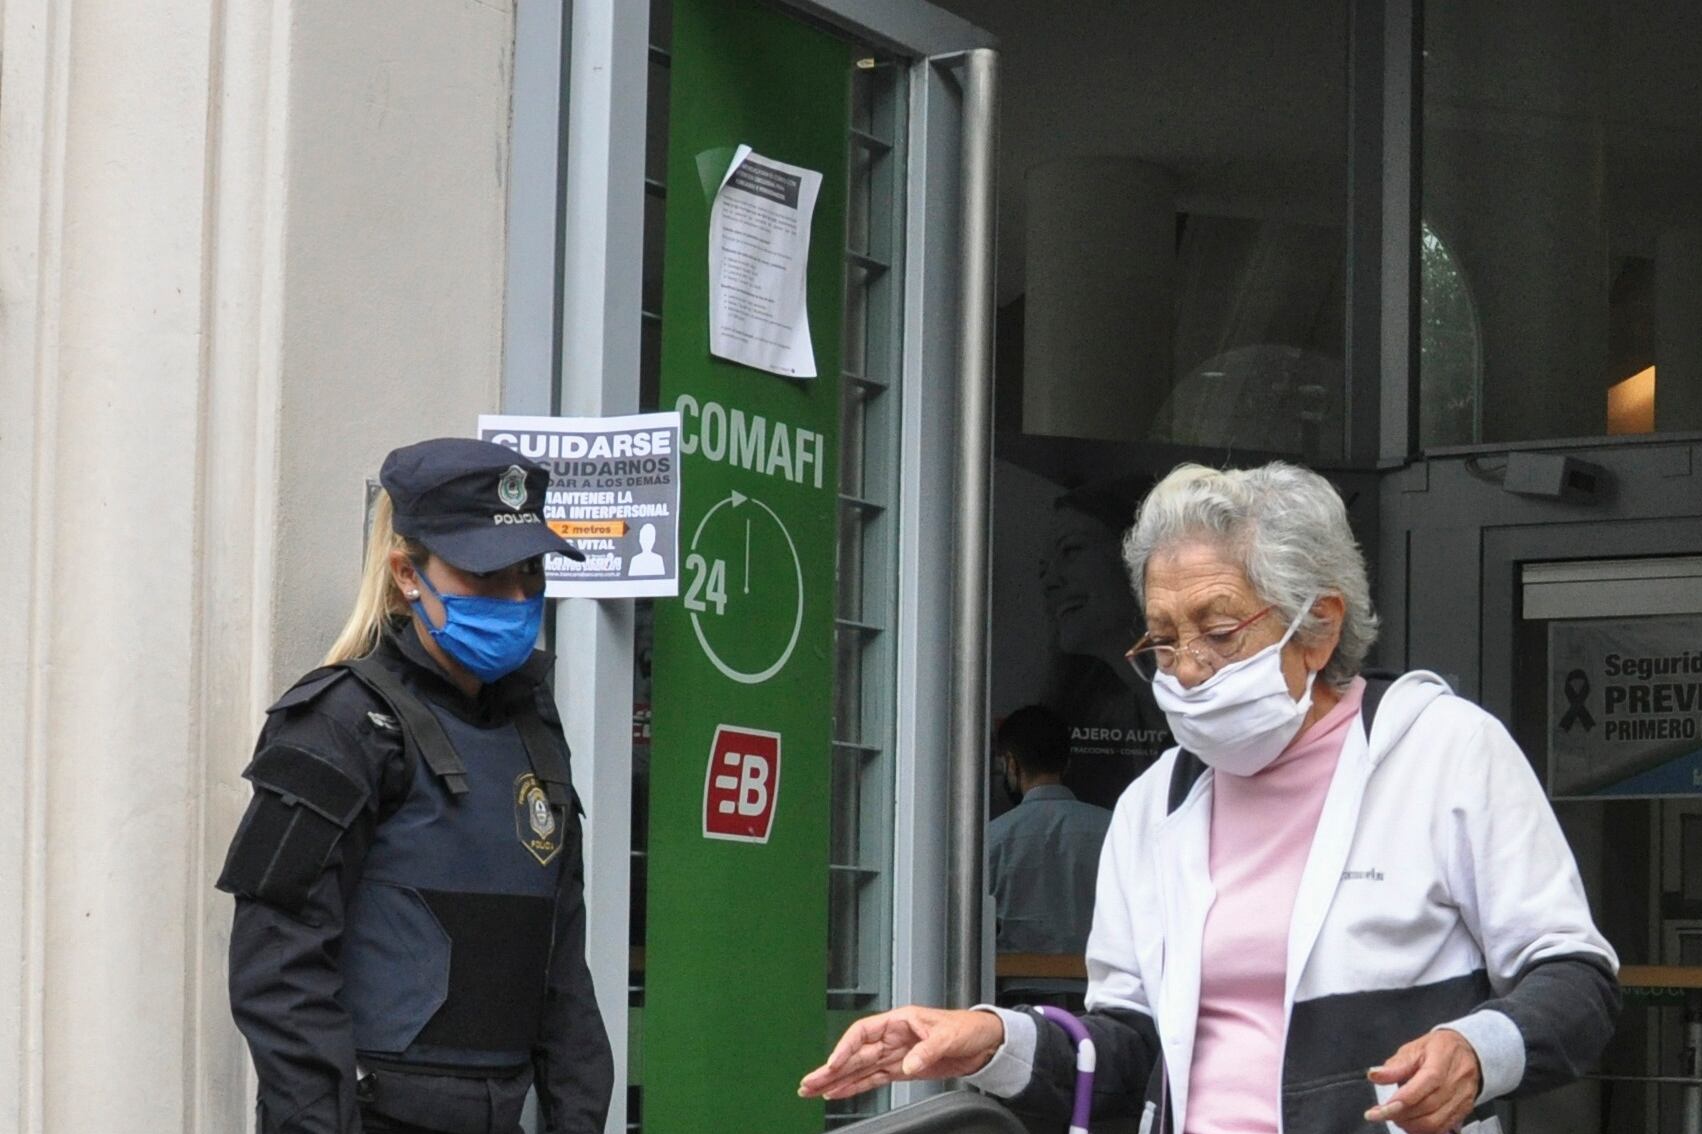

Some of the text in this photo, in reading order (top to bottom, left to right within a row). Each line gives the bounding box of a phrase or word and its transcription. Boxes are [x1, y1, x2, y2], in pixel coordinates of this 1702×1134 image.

[675, 393, 824, 489] COMAFI
[540, 457, 671, 477] UIDARNOS
[578, 480, 591, 488] A
[597, 478, 623, 487] LOS
[626, 475, 671, 486] DEMÁS
[617, 491, 633, 503] LA
[569, 503, 670, 519] INTERPERSONAL
[561, 525, 612, 534] 2 metros
[577, 539, 616, 550] VITAL
[683, 553, 728, 616] 24
[1604, 717, 1696, 741] PRIMERO
